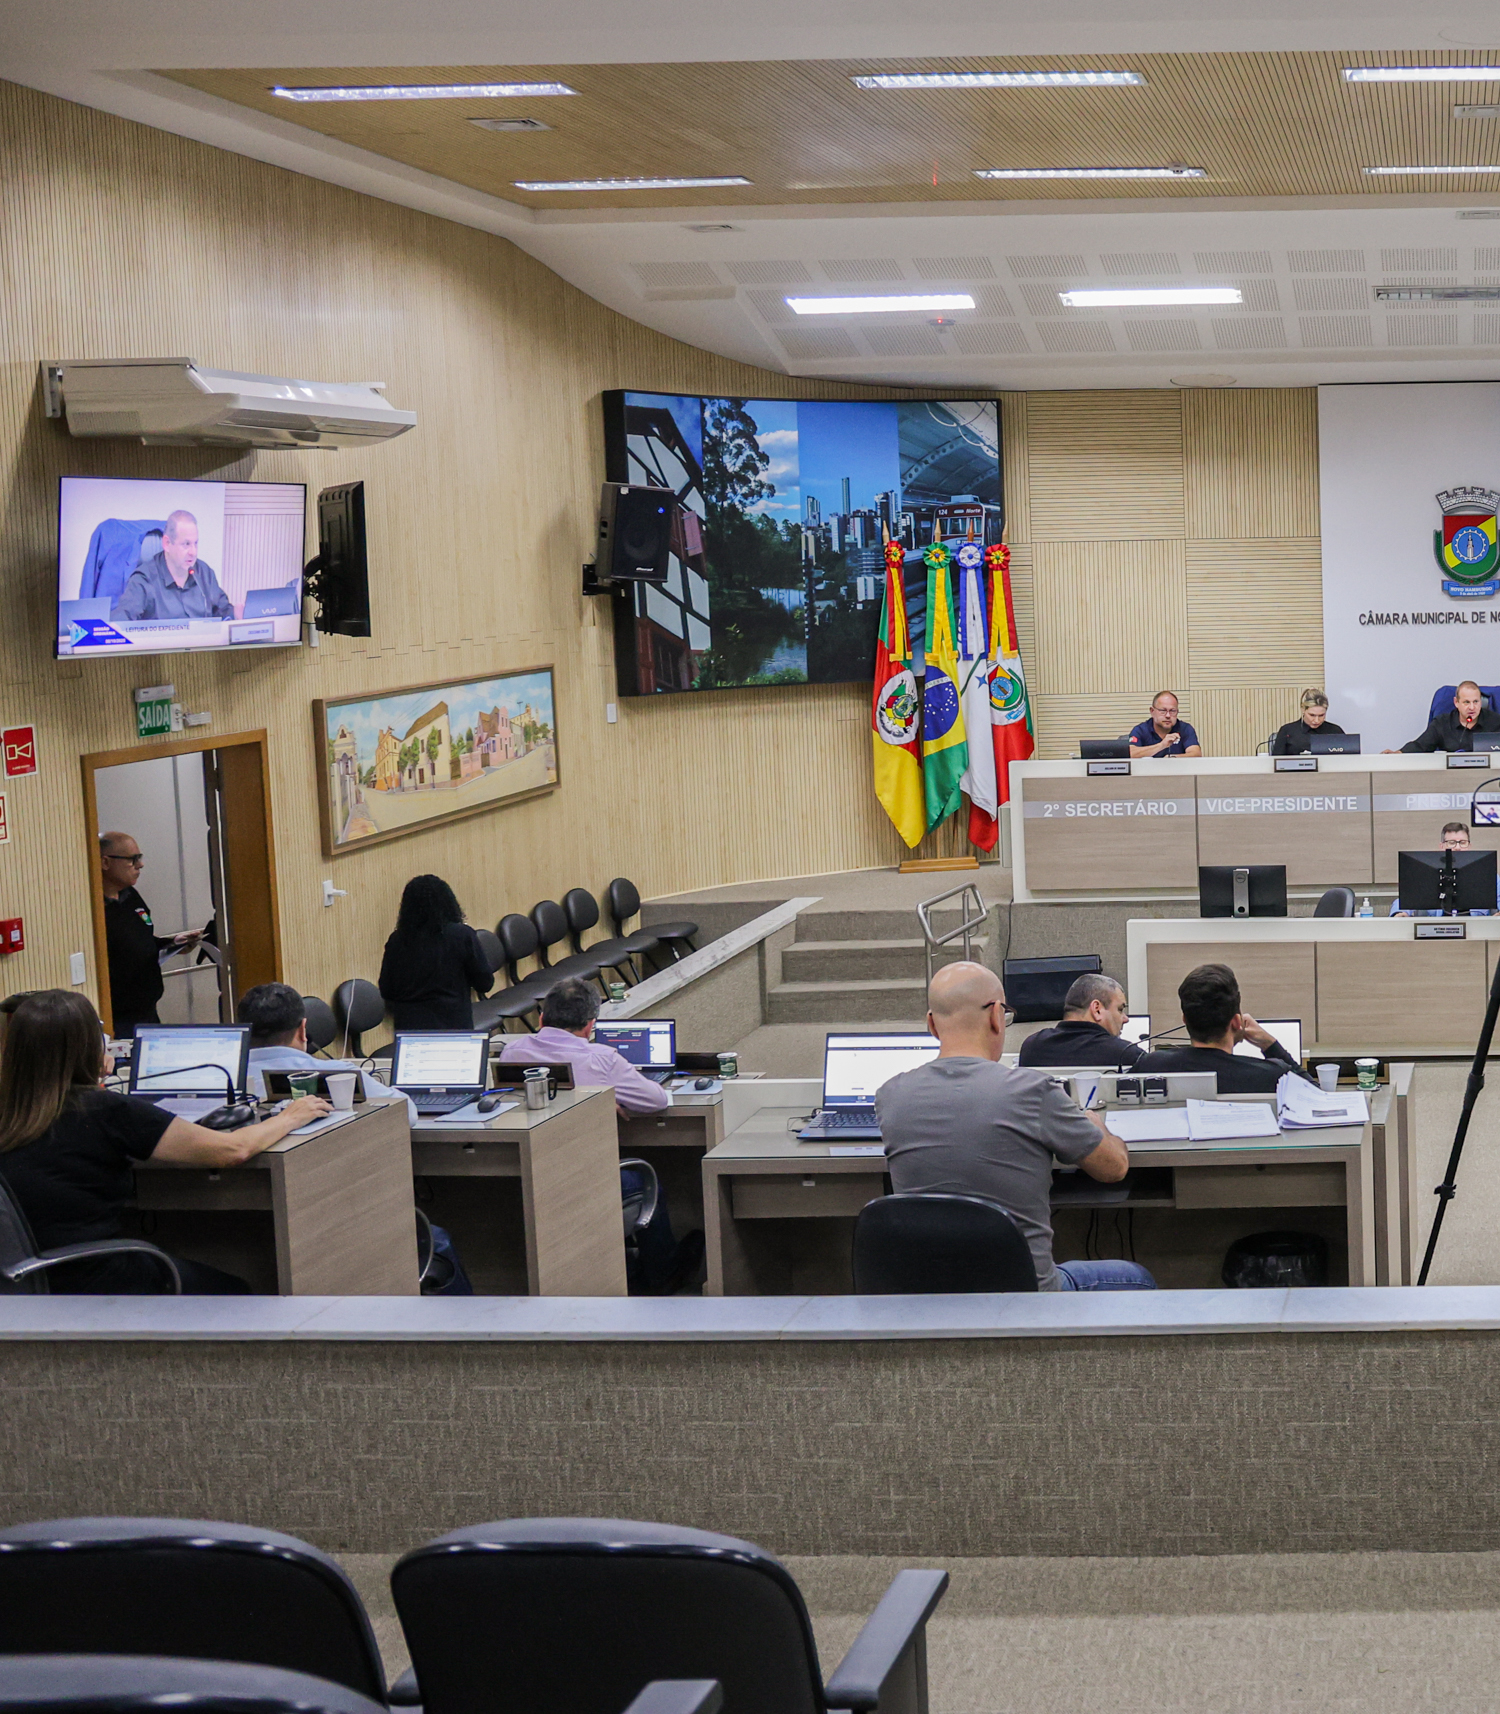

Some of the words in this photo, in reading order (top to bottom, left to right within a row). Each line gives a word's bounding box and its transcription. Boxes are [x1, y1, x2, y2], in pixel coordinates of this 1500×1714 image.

[1359, 610, 1408, 625] CÂMARA
[1412, 611, 1468, 625] MUNICIPAL
[1471, 611, 1486, 624] DE
[139, 702, 170, 729] SAÍDA
[1065, 799, 1178, 817] SECRETÁRIO
[1206, 796, 1358, 813] VICE-PRESIDENTE
